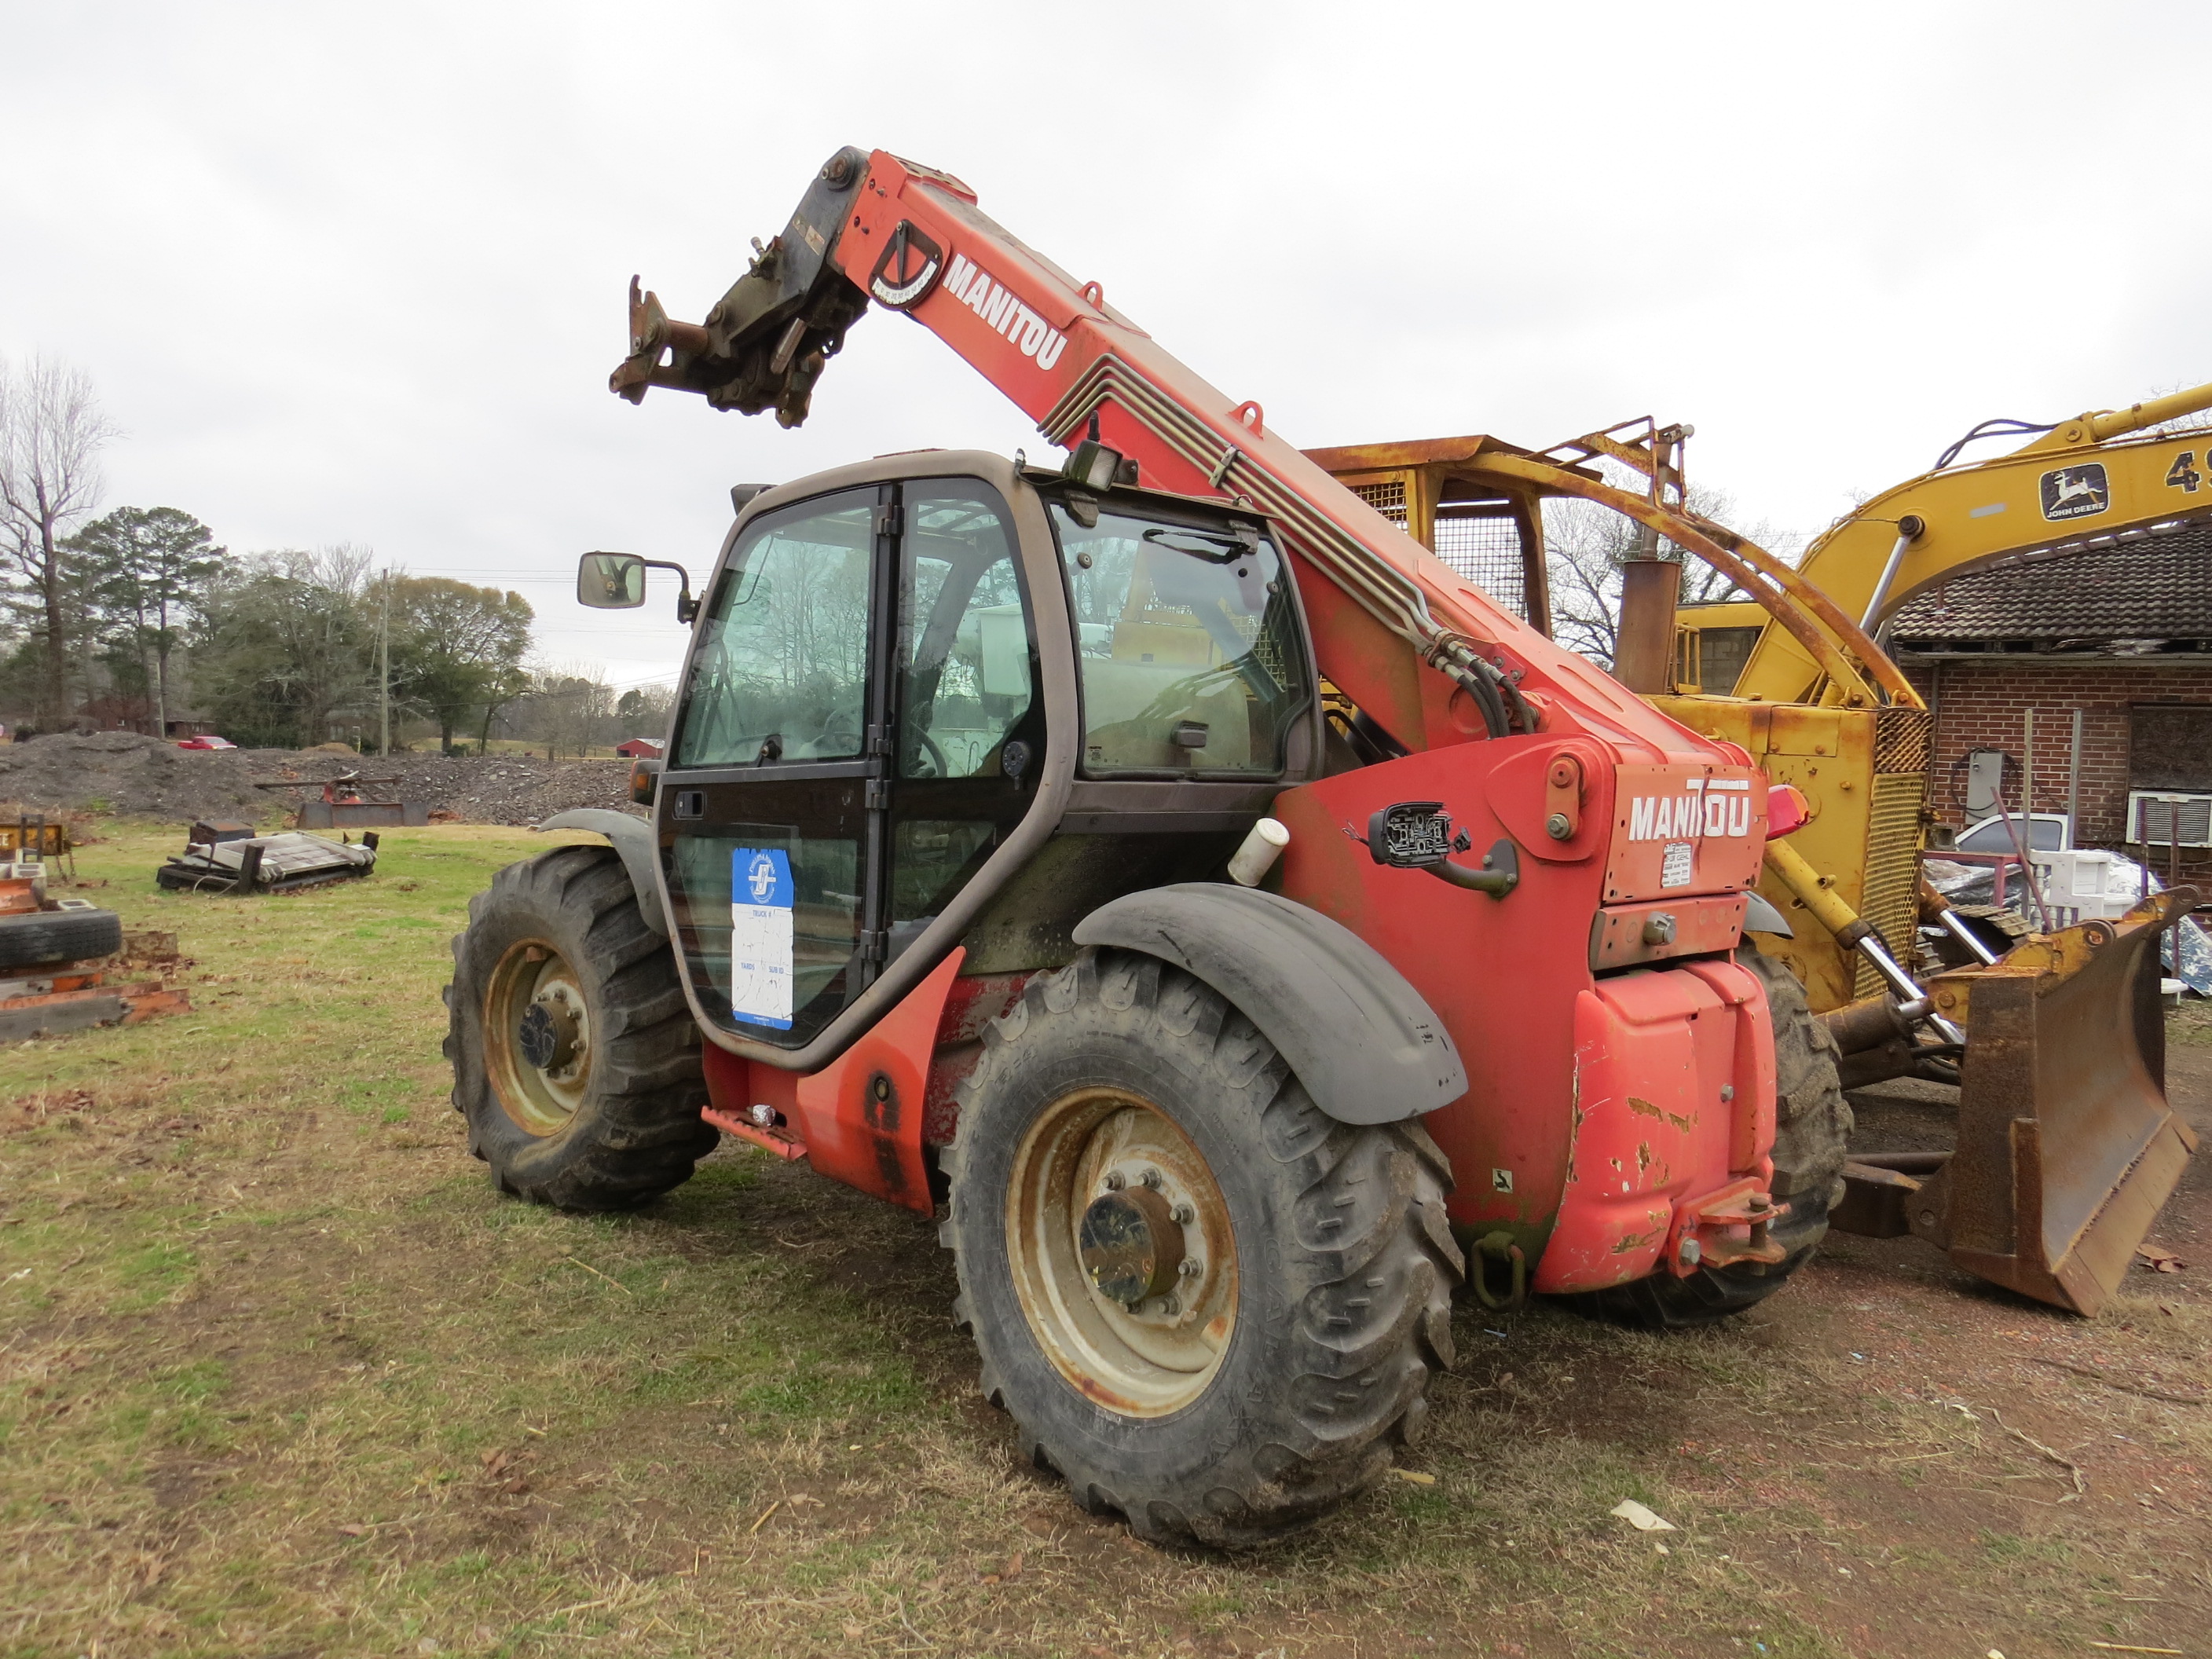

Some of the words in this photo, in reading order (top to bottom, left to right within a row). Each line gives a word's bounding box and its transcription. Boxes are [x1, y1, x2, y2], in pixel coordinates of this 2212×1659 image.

[942, 252, 1068, 372] MANITOU
[2046, 507, 2073, 518] JOHN
[2074, 502, 2105, 515] DEERE
[1628, 778, 1749, 840] MANITOU
